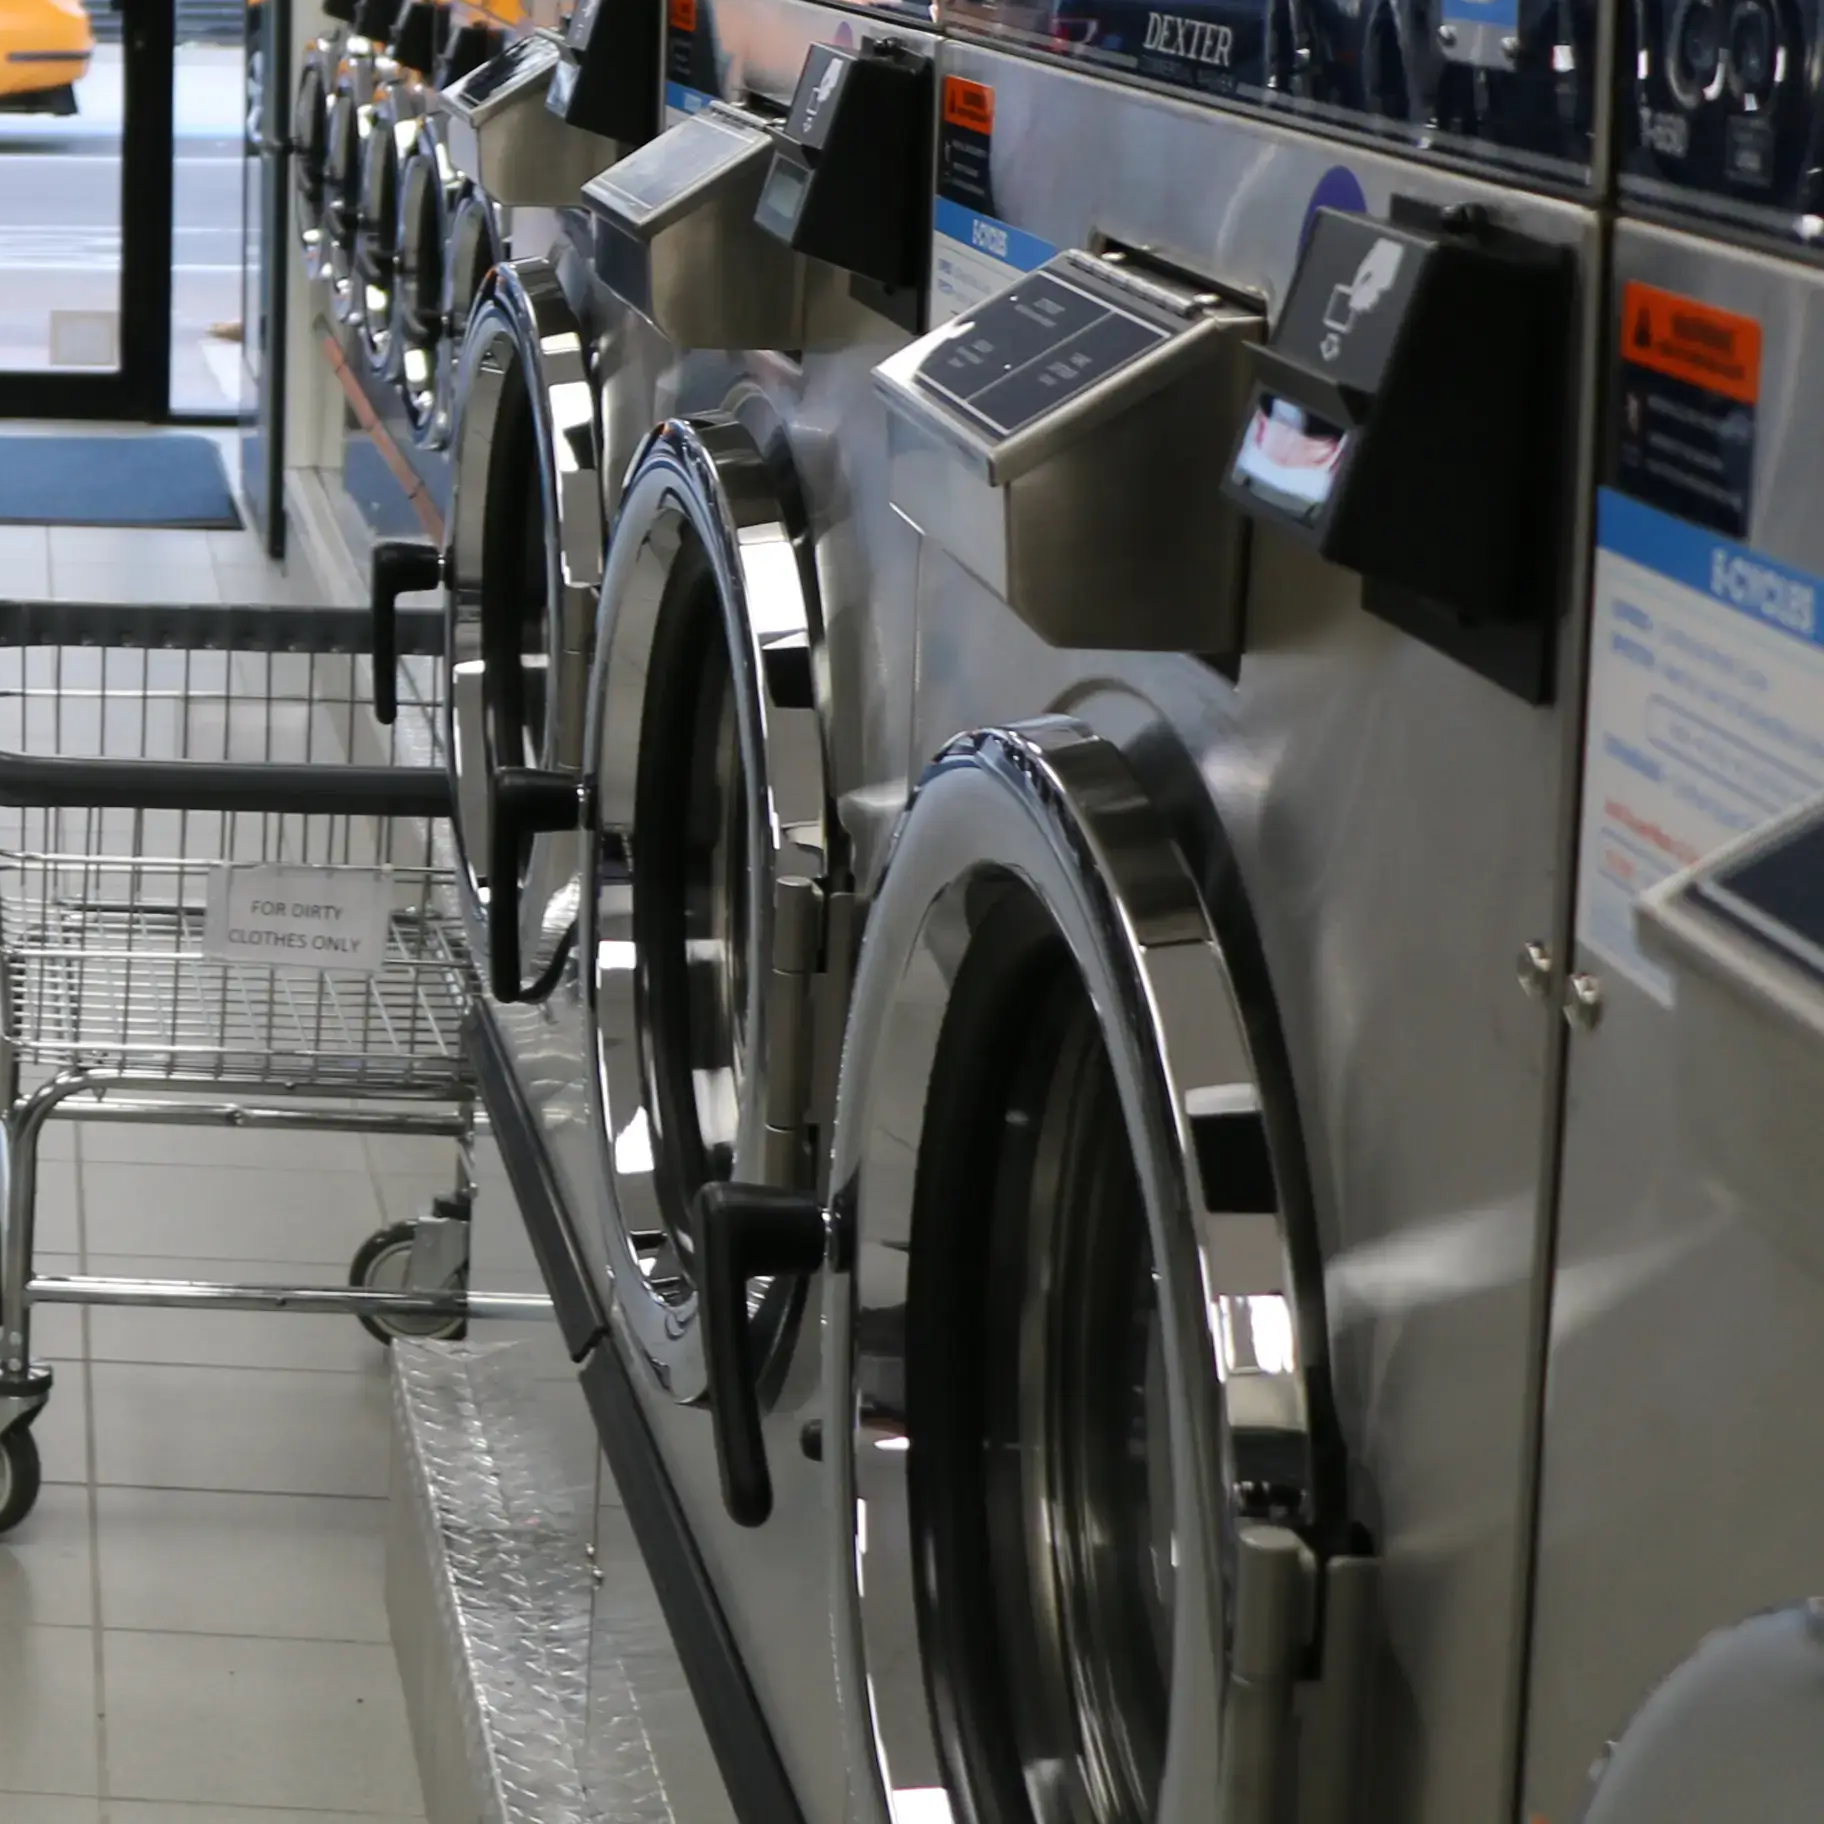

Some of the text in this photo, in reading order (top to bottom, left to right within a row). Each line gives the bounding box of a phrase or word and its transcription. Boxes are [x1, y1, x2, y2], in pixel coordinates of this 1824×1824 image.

[1143, 12, 1233, 67] DEXTER
[251, 900, 344, 920] FOR DIRTY
[228, 929, 361, 953] CLOTHES ONLY
